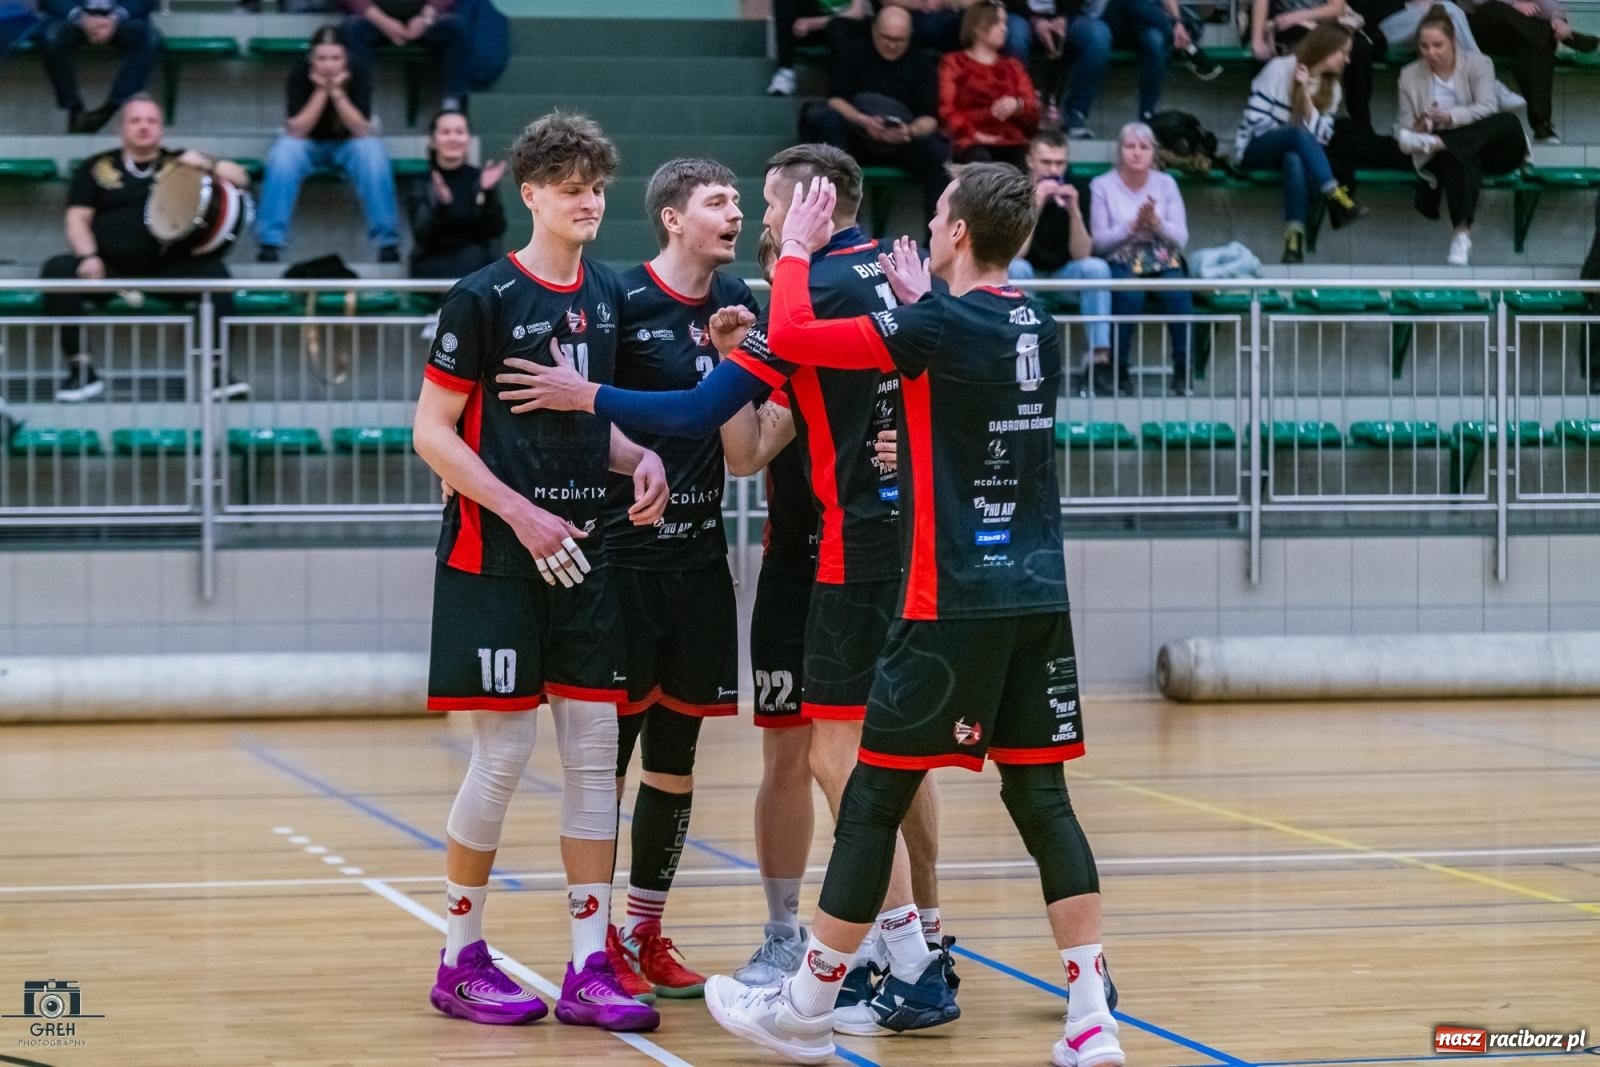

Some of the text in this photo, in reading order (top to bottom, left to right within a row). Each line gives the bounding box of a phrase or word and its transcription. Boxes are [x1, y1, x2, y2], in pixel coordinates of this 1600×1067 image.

[1017, 403, 1043, 415] VOLLEY
[988, 419, 1030, 434] DĄBROWA
[478, 648, 517, 693] 10
[755, 670, 797, 712] 22
